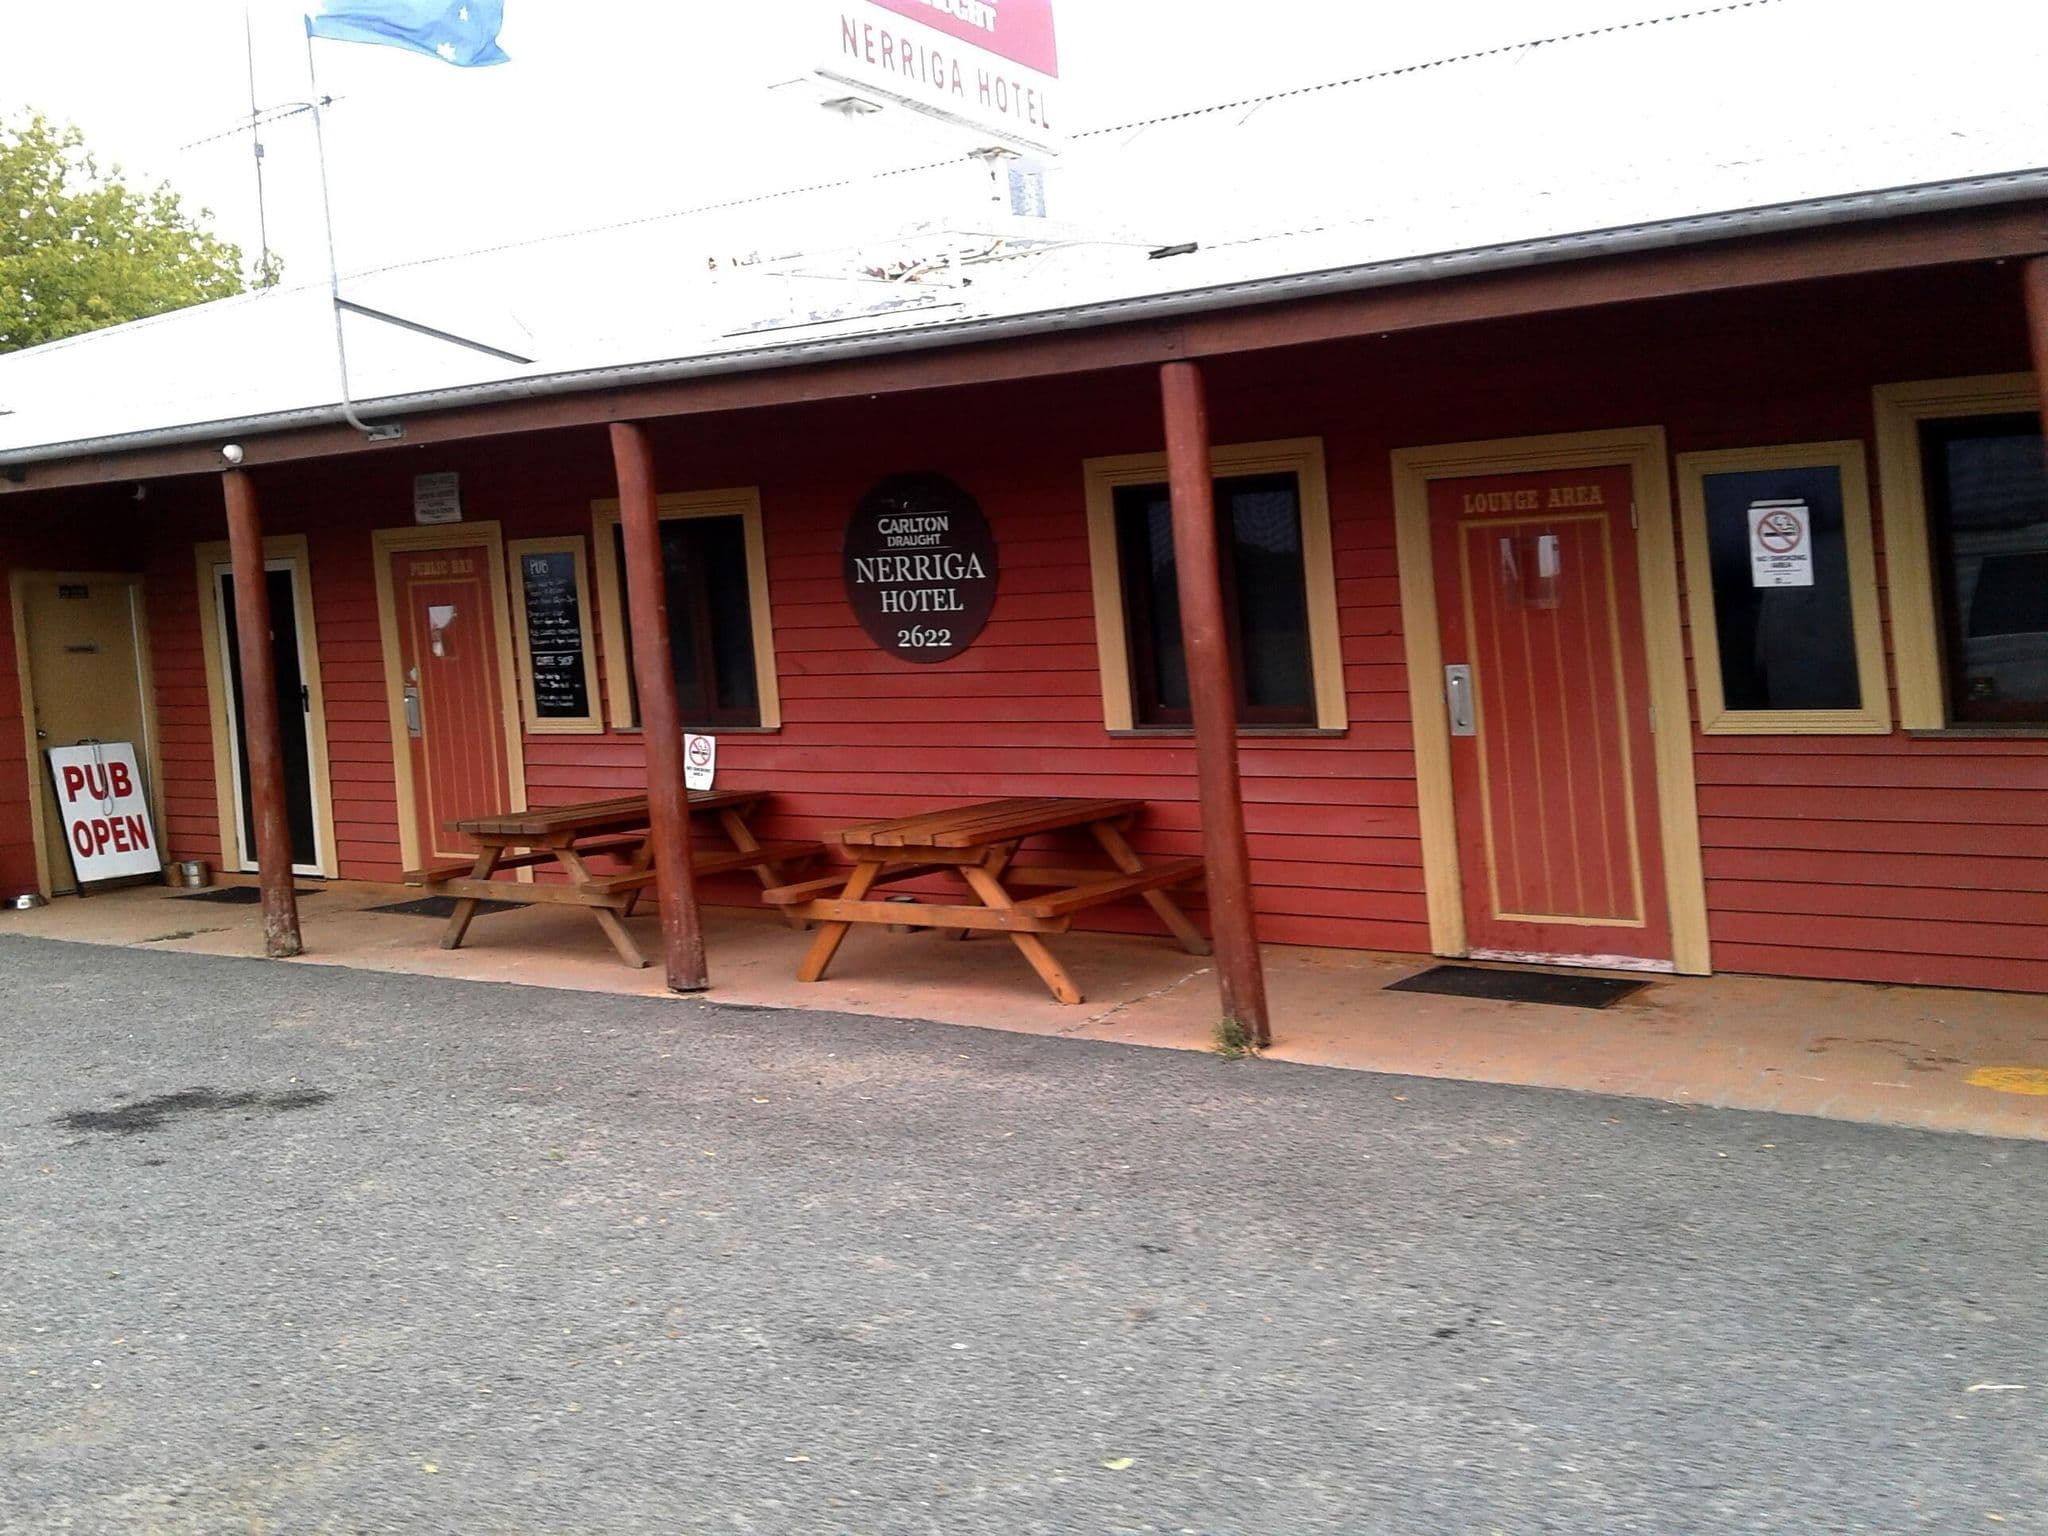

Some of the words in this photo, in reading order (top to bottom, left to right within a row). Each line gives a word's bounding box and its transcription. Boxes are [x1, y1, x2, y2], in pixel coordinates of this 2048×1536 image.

[841, 14, 964, 98] NERRIGA
[978, 68, 1050, 129] HOTEL
[1463, 490, 1539, 514] LOUNGE
[1548, 485, 1605, 508] AREA
[878, 516, 949, 534] CARLTON
[887, 533, 941, 547] DRAUGHT
[529, 559, 549, 575] PUB
[854, 552, 986, 583] NERRIGA
[880, 588, 964, 613] HOTEL
[897, 625, 953, 647] 2622
[62, 762, 133, 803] PUB
[73, 814, 150, 858] OPEN
